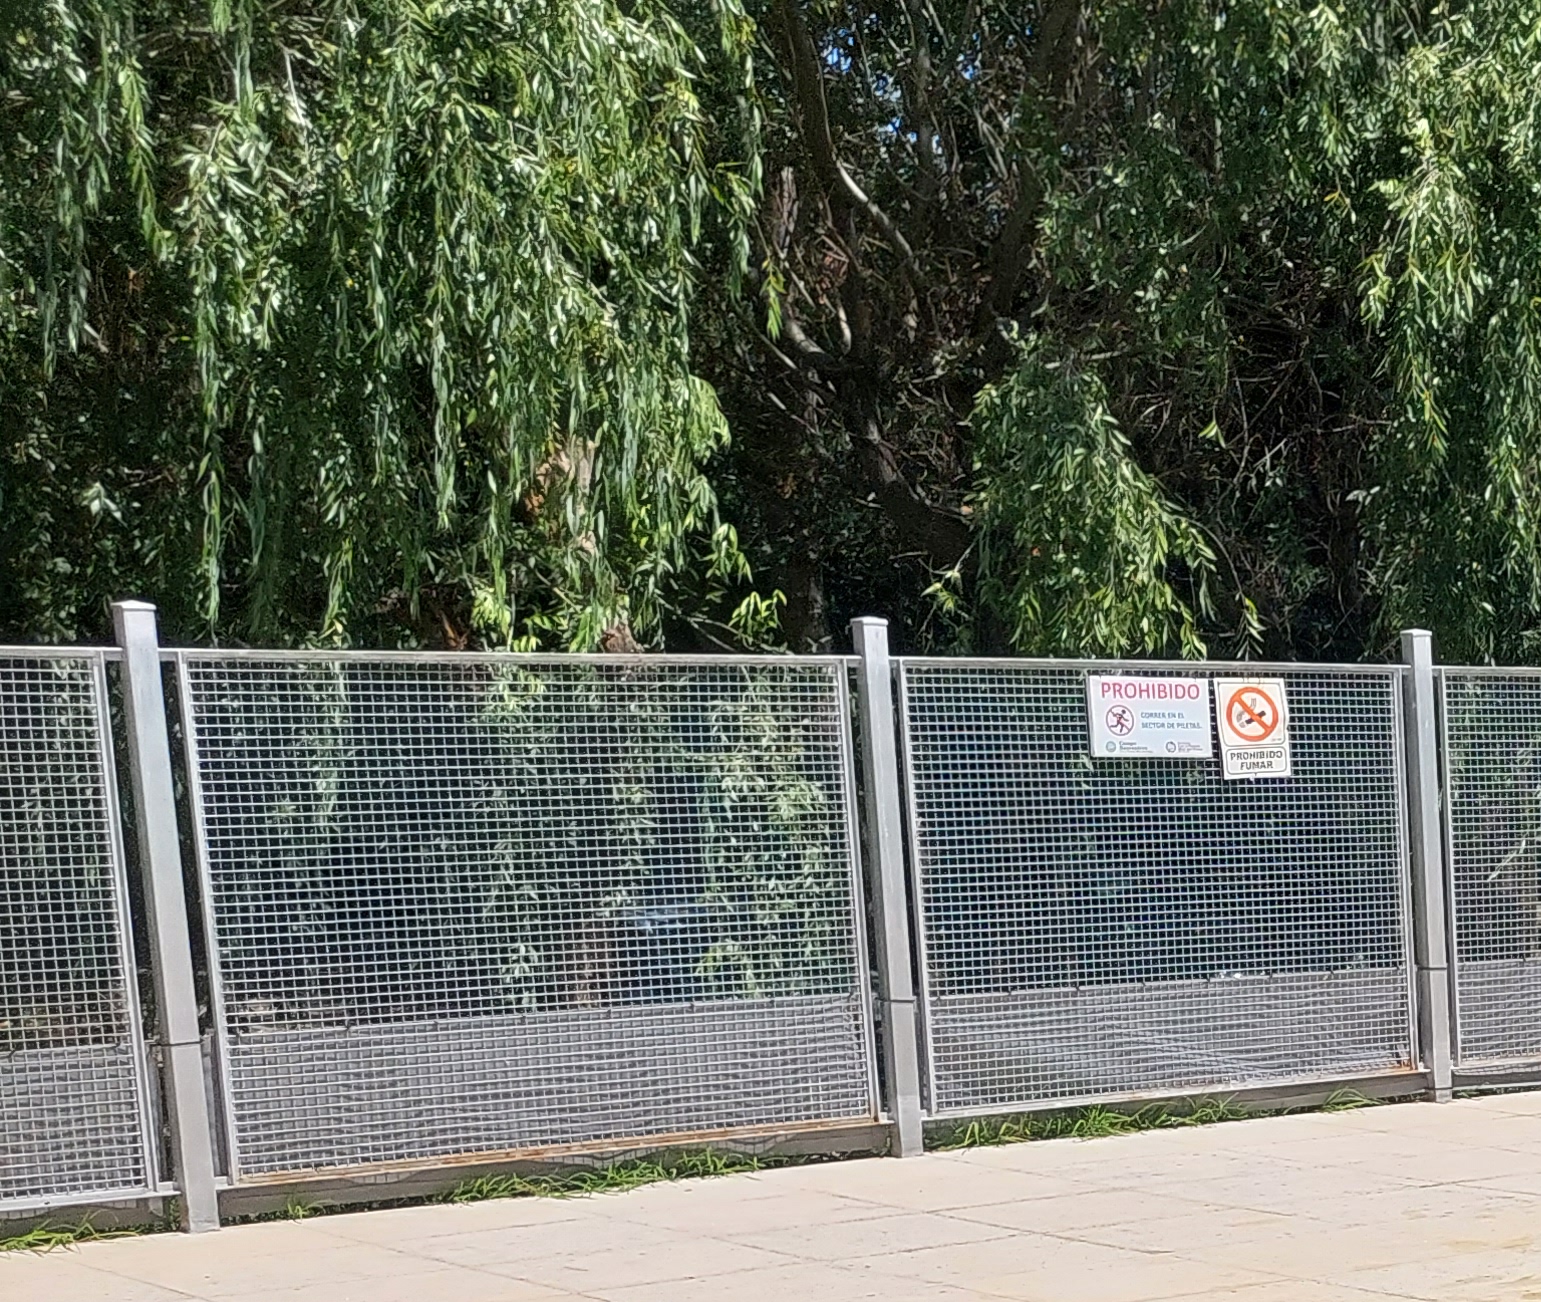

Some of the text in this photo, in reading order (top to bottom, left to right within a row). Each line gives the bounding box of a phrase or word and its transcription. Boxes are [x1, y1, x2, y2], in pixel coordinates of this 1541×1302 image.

[1101, 682, 1200, 700] PROHIBIDO
[1230, 750, 1283, 761] PROHIBIDO
[1240, 760, 1274, 770] FUMAR
